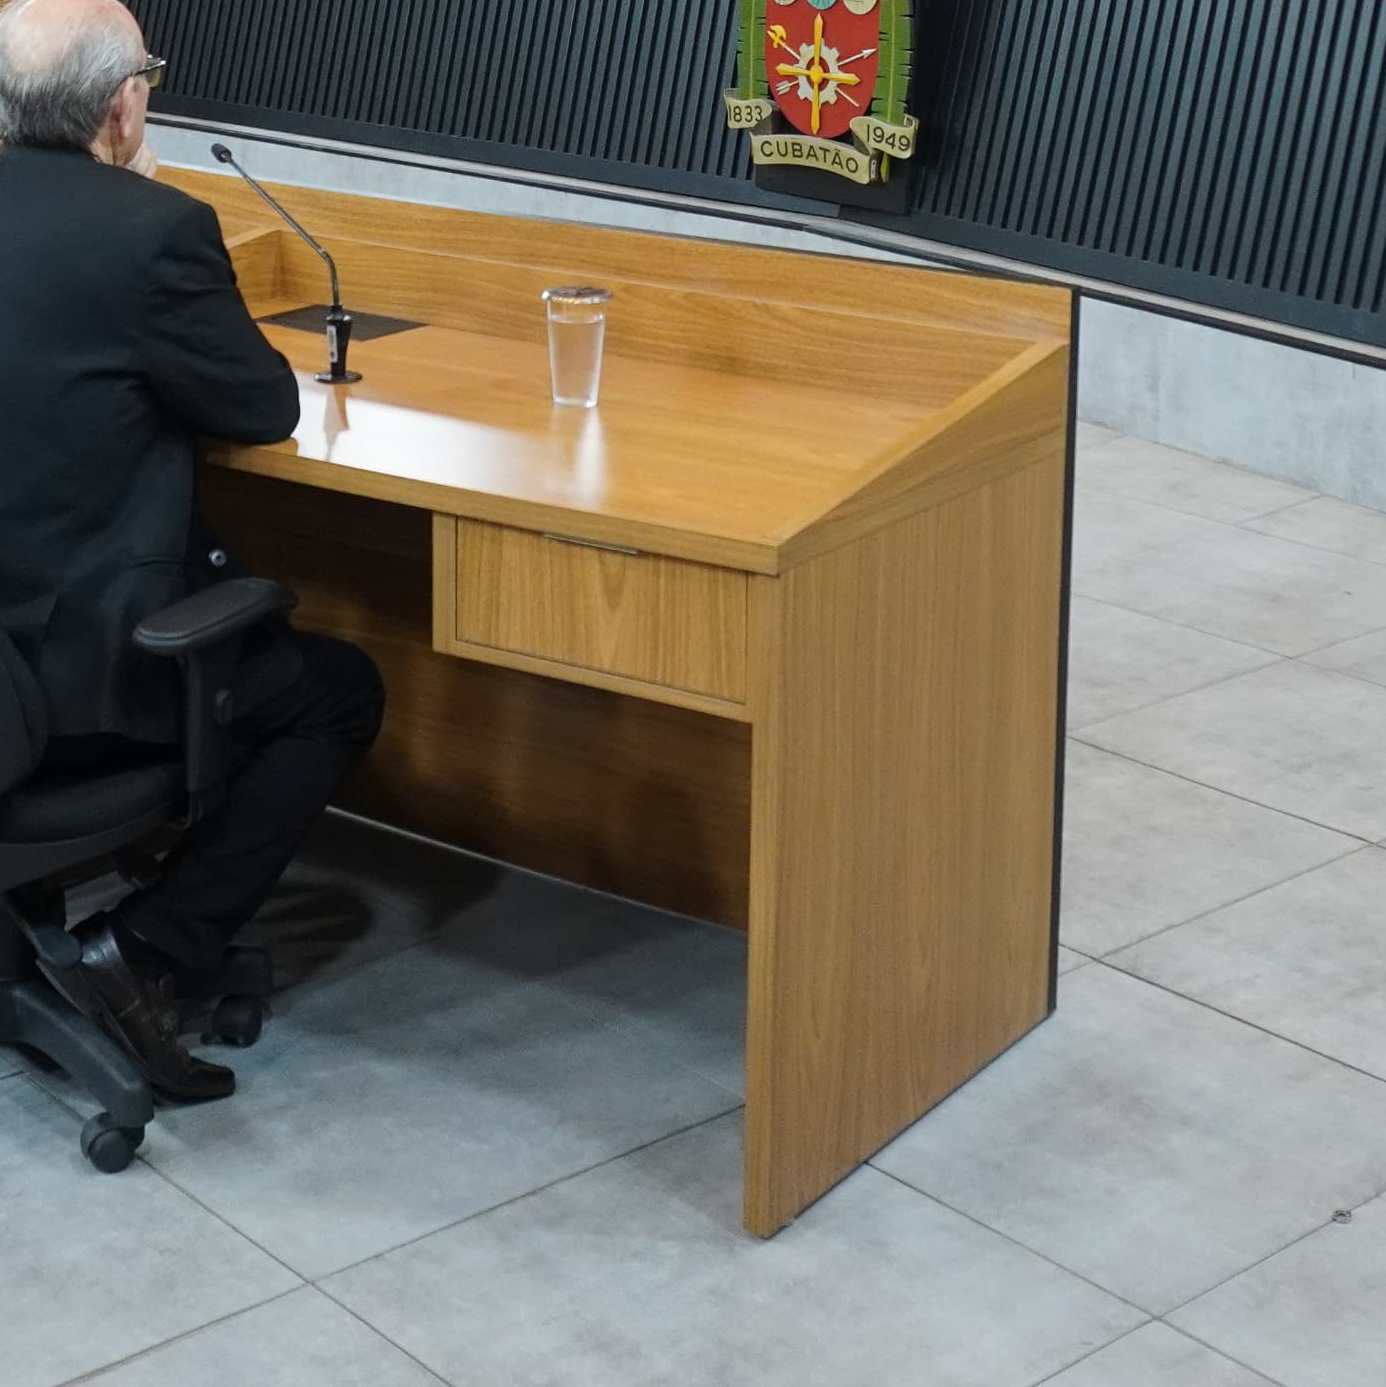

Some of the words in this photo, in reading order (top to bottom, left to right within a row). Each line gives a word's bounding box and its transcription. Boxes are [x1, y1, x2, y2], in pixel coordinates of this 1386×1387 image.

[728, 104, 763, 123] 1833
[866, 123, 911, 152] 1949
[760, 140, 859, 174] CUBATÃO
